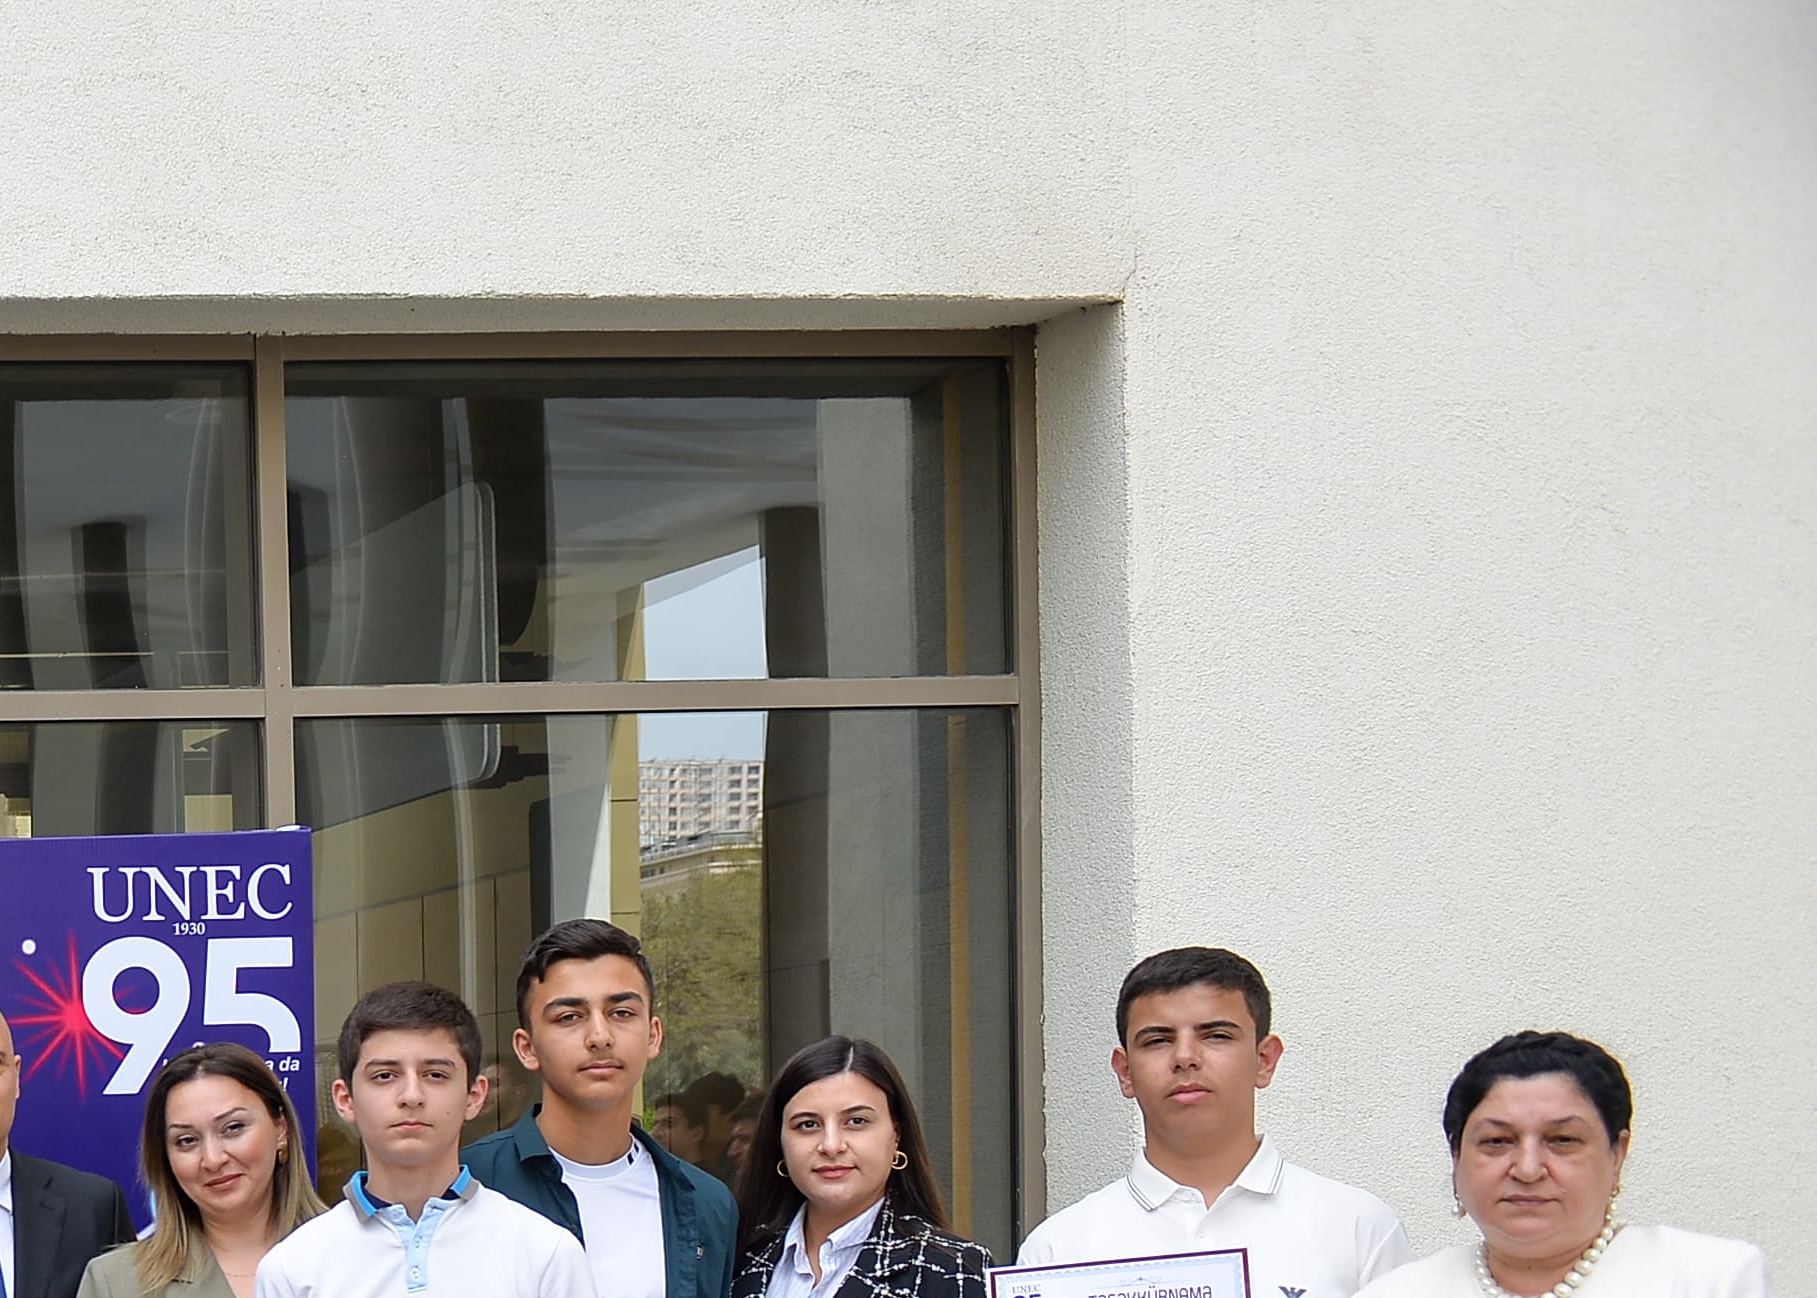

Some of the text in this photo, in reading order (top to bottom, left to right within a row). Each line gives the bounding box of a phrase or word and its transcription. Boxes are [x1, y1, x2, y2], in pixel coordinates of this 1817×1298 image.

[87, 863, 293, 923] UNEC
[173, 922, 206, 936] 1930
[82, 936, 301, 1095] 95
[278, 1057, 300, 1072] da
[1012, 1285, 1042, 1295] UNEC
